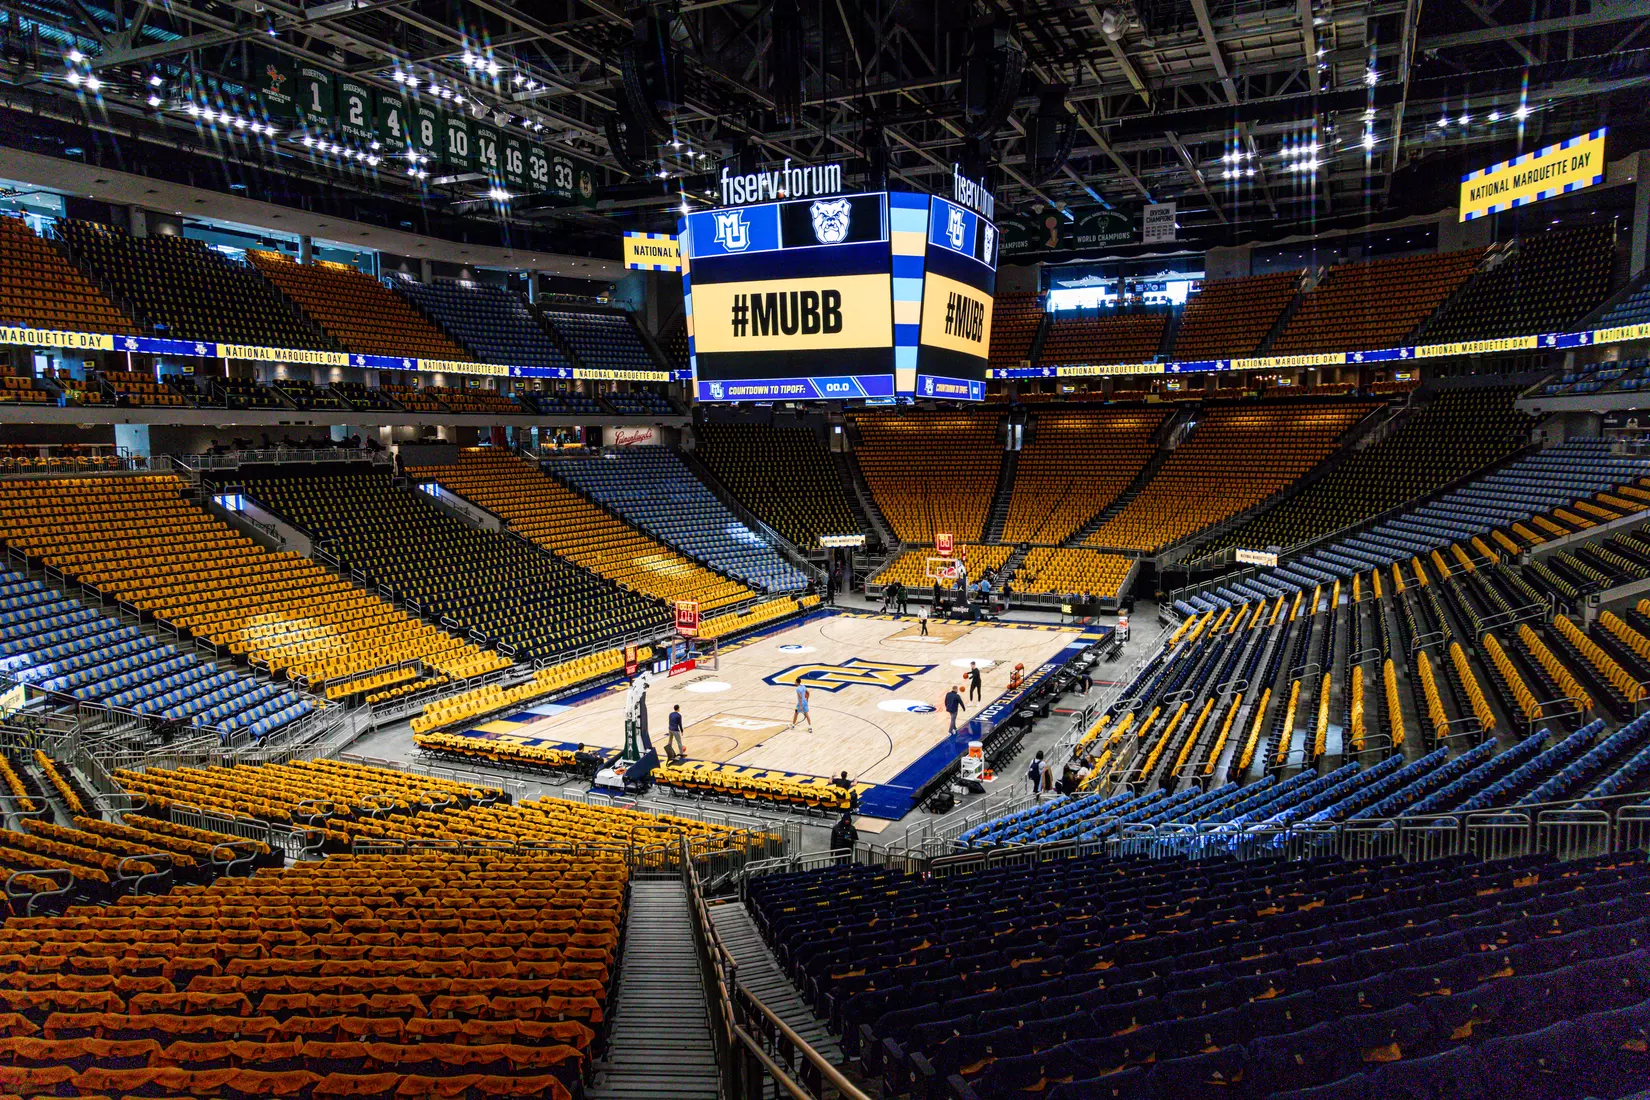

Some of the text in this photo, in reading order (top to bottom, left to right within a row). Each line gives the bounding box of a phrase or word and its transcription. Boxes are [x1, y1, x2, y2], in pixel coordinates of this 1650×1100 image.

[302, 68, 328, 84] ROBERTSON
[310, 82, 322, 113] 1
[343, 83, 367, 98] BRIDGEMAN
[349, 96, 364, 126] 2
[387, 109, 401, 137] 4
[421, 119, 433, 147] 8
[448, 128, 468, 157] 10
[479, 138, 497, 167] 14
[506, 147, 522, 174] 16
[529, 155, 548, 183] 32
[555, 164, 573, 190] 33
[1470, 152, 1591, 202] NATIONAL MARQUETTE DAY
[1146, 215, 1173, 223] CHAMPIONS
[1150, 208, 1170, 217] DIVISION
[713, 209, 751, 253] MU
[1077, 232, 1131, 243] WORLD CHAMPIONS
[633, 244, 672, 258] NATIONAL
[998, 240, 1029, 250] CHAMPIONS
[731, 289, 843, 338] #MUBB
[945, 291, 984, 343] #MUBB
[0, 329, 102, 347] MARQUETTE DAY
[1600, 327, 1634, 341] NATIONAL
[225, 345, 342, 364] NATIONAL MARQUETTE DAY
[1421, 338, 1529, 355] NATIONAL MARQUETTE DAY
[423, 360, 504, 375] NATIONAL MARQUETTE DAY
[1237, 354, 1338, 368] NATIONAL MARQUETTE DAY
[579, 370, 611, 379] NATIONAL
[613, 371, 650, 380] MARQUETTE
[1063, 364, 1157, 376] NATIONAL MARQUETTE DAY
[728, 384, 806, 396] COUNTDOWN TO TIPOFF:
[826, 383, 849, 392] 00.0
